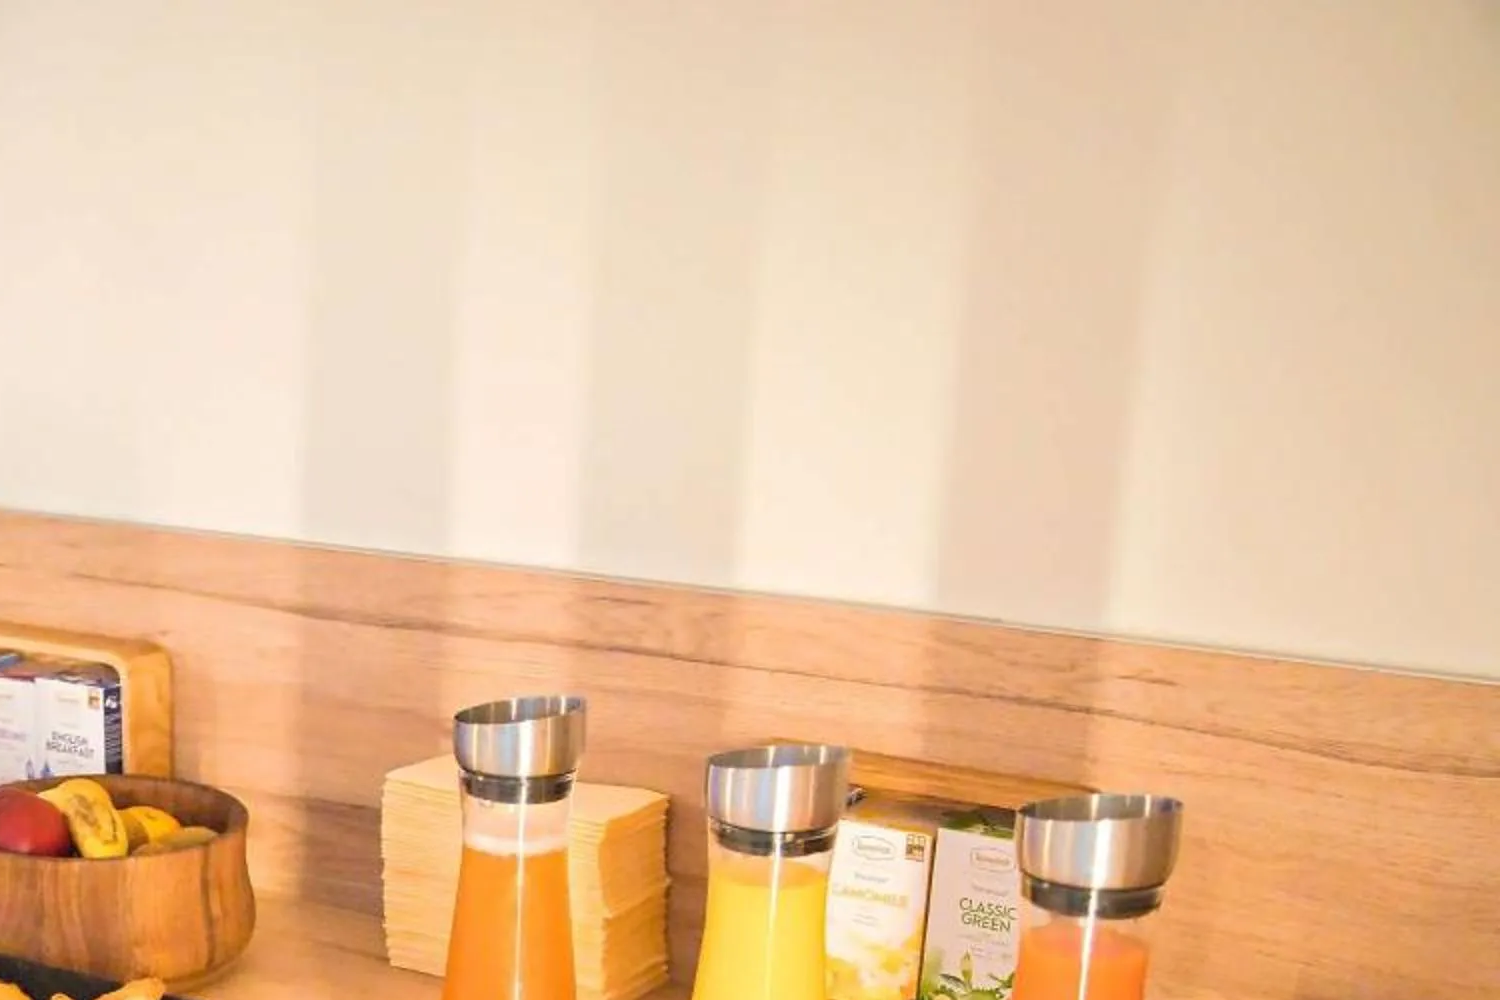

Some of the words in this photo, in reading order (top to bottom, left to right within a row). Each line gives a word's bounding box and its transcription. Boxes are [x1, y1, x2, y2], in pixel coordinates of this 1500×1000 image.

[46, 740, 95, 758] BREAKFAST
[959, 897, 1017, 921] CLASSIC
[961, 912, 1011, 933] GREEN
